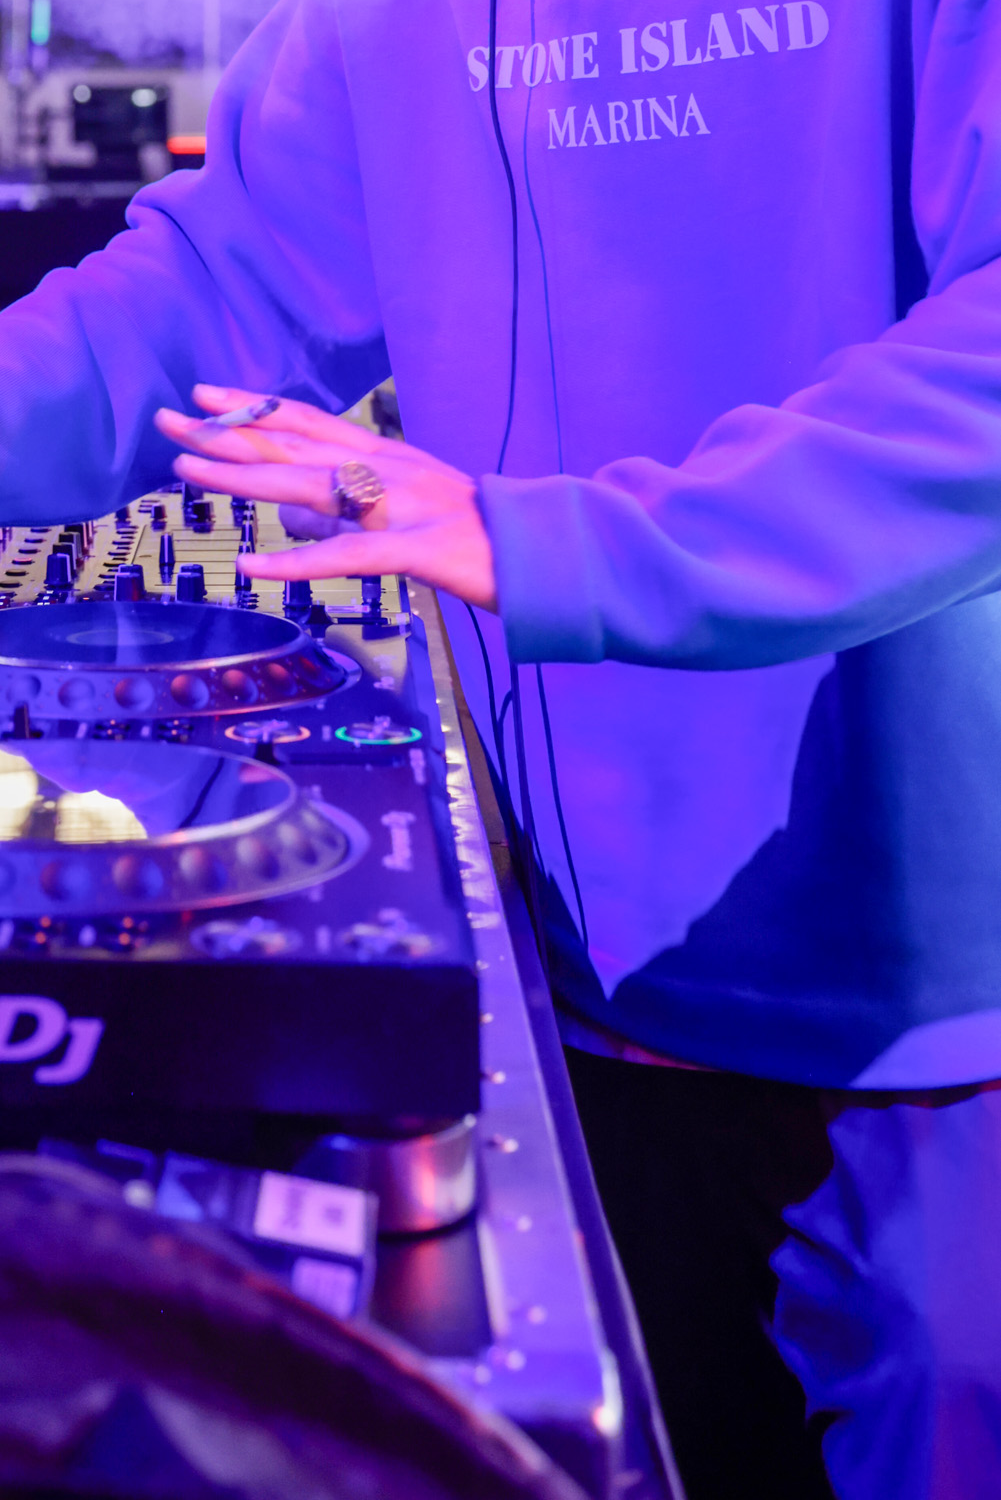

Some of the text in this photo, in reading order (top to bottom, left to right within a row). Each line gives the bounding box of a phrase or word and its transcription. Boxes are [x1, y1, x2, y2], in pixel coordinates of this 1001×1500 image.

[466, 0, 829, 93] STONE ISLAND
[547, 92, 711, 150] MARINA
